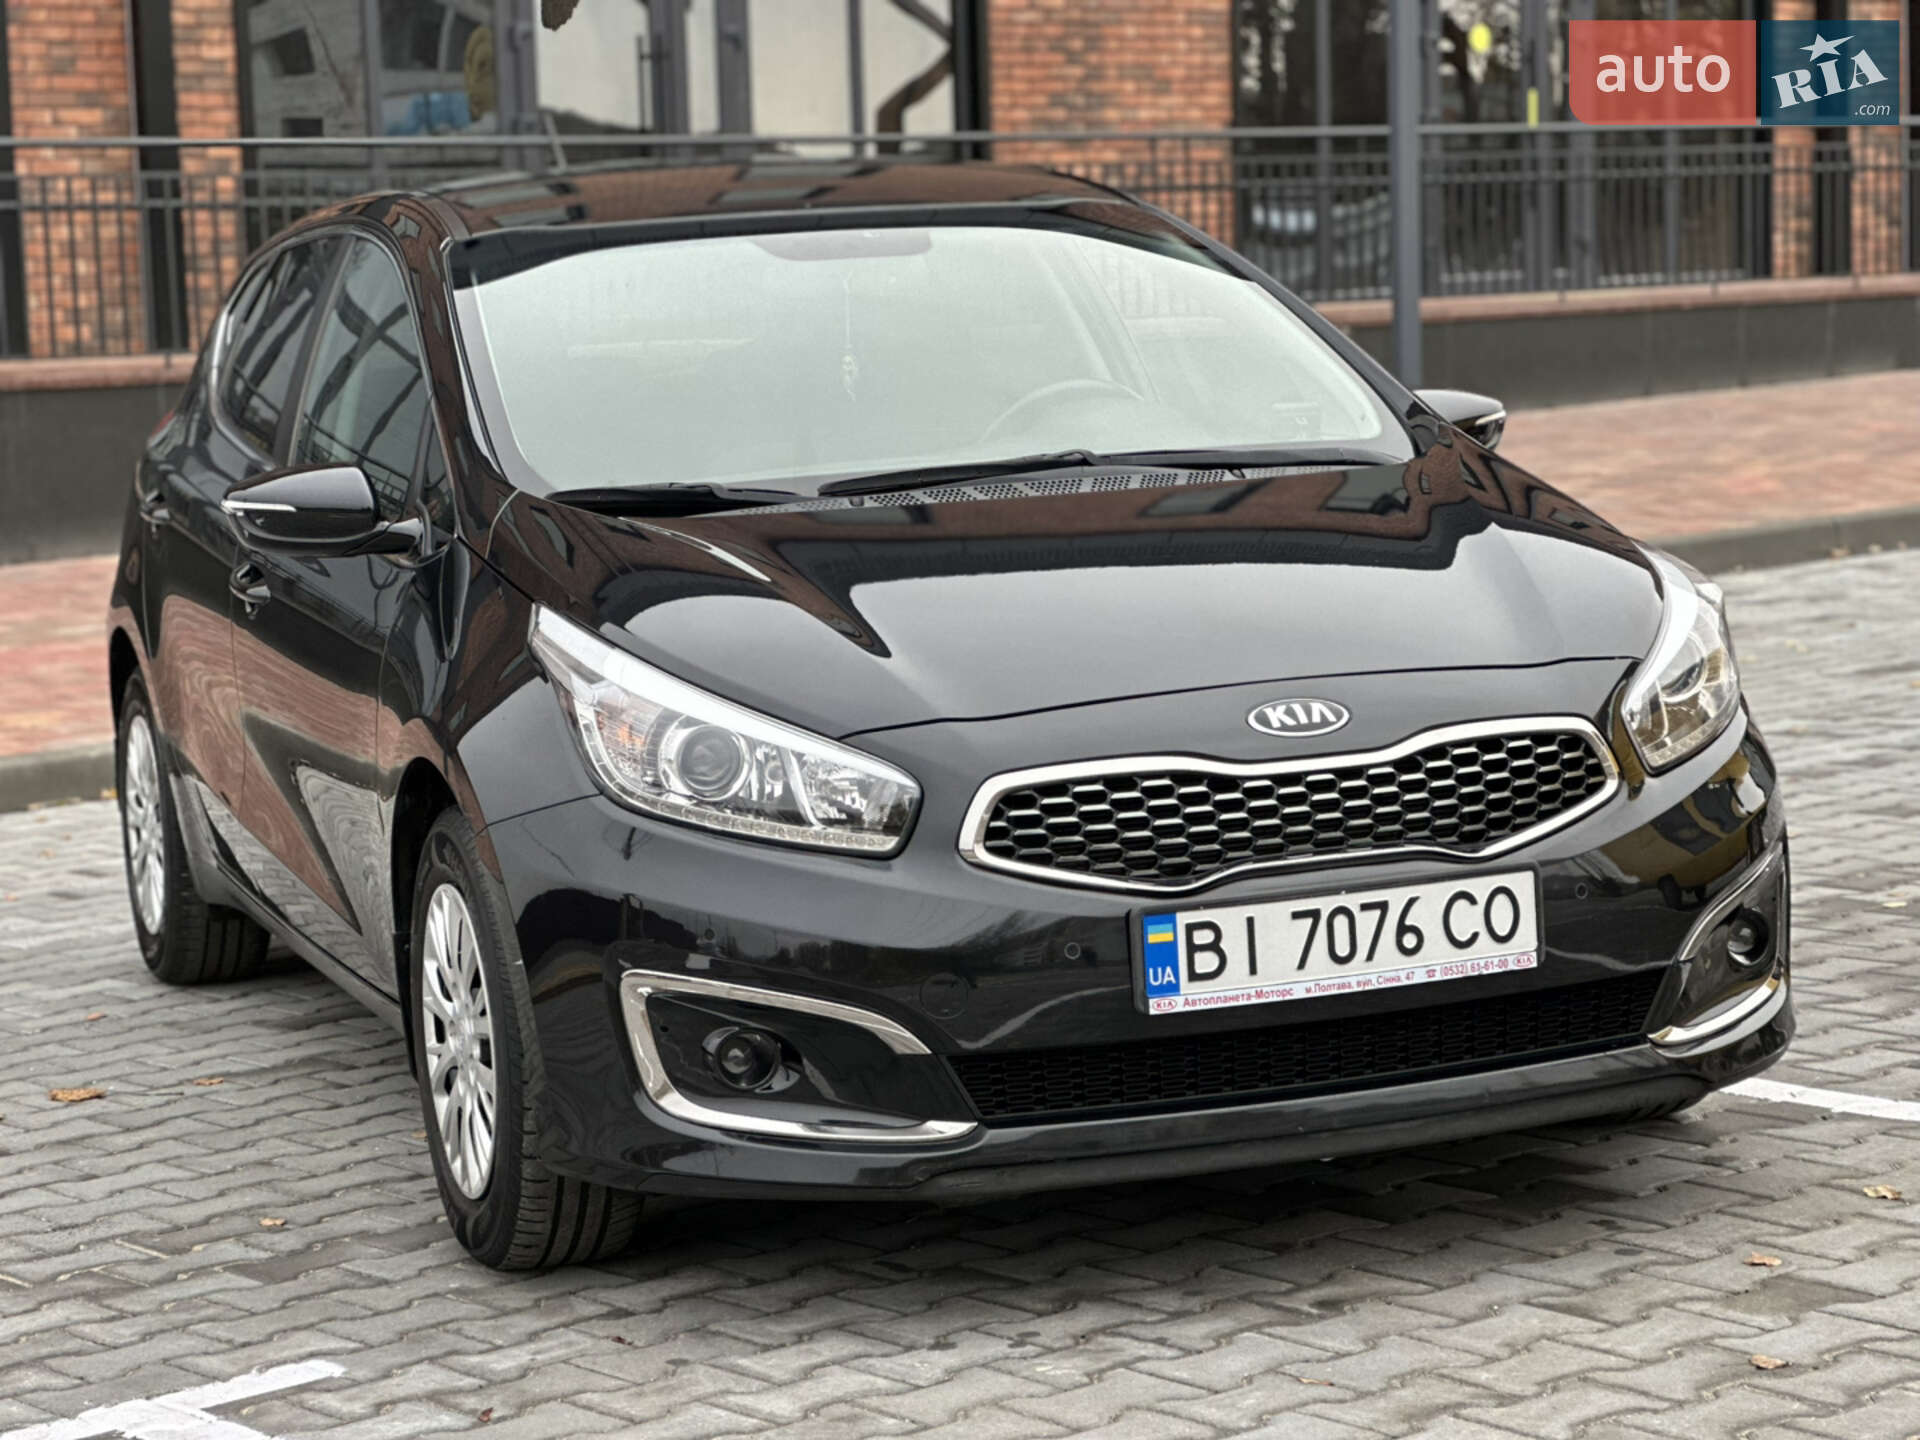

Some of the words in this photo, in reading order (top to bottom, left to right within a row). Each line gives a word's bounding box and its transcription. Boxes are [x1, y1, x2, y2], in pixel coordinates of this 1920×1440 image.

[1261, 702, 1338, 729] KIA
[1185, 916, 1258, 983] BI
[1291, 896, 1425, 971] 7076
[1442, 885, 1521, 950] CO
[1149, 967, 1176, 986] UA
[1182, 987, 1294, 1008] Автопланета-Моторс
